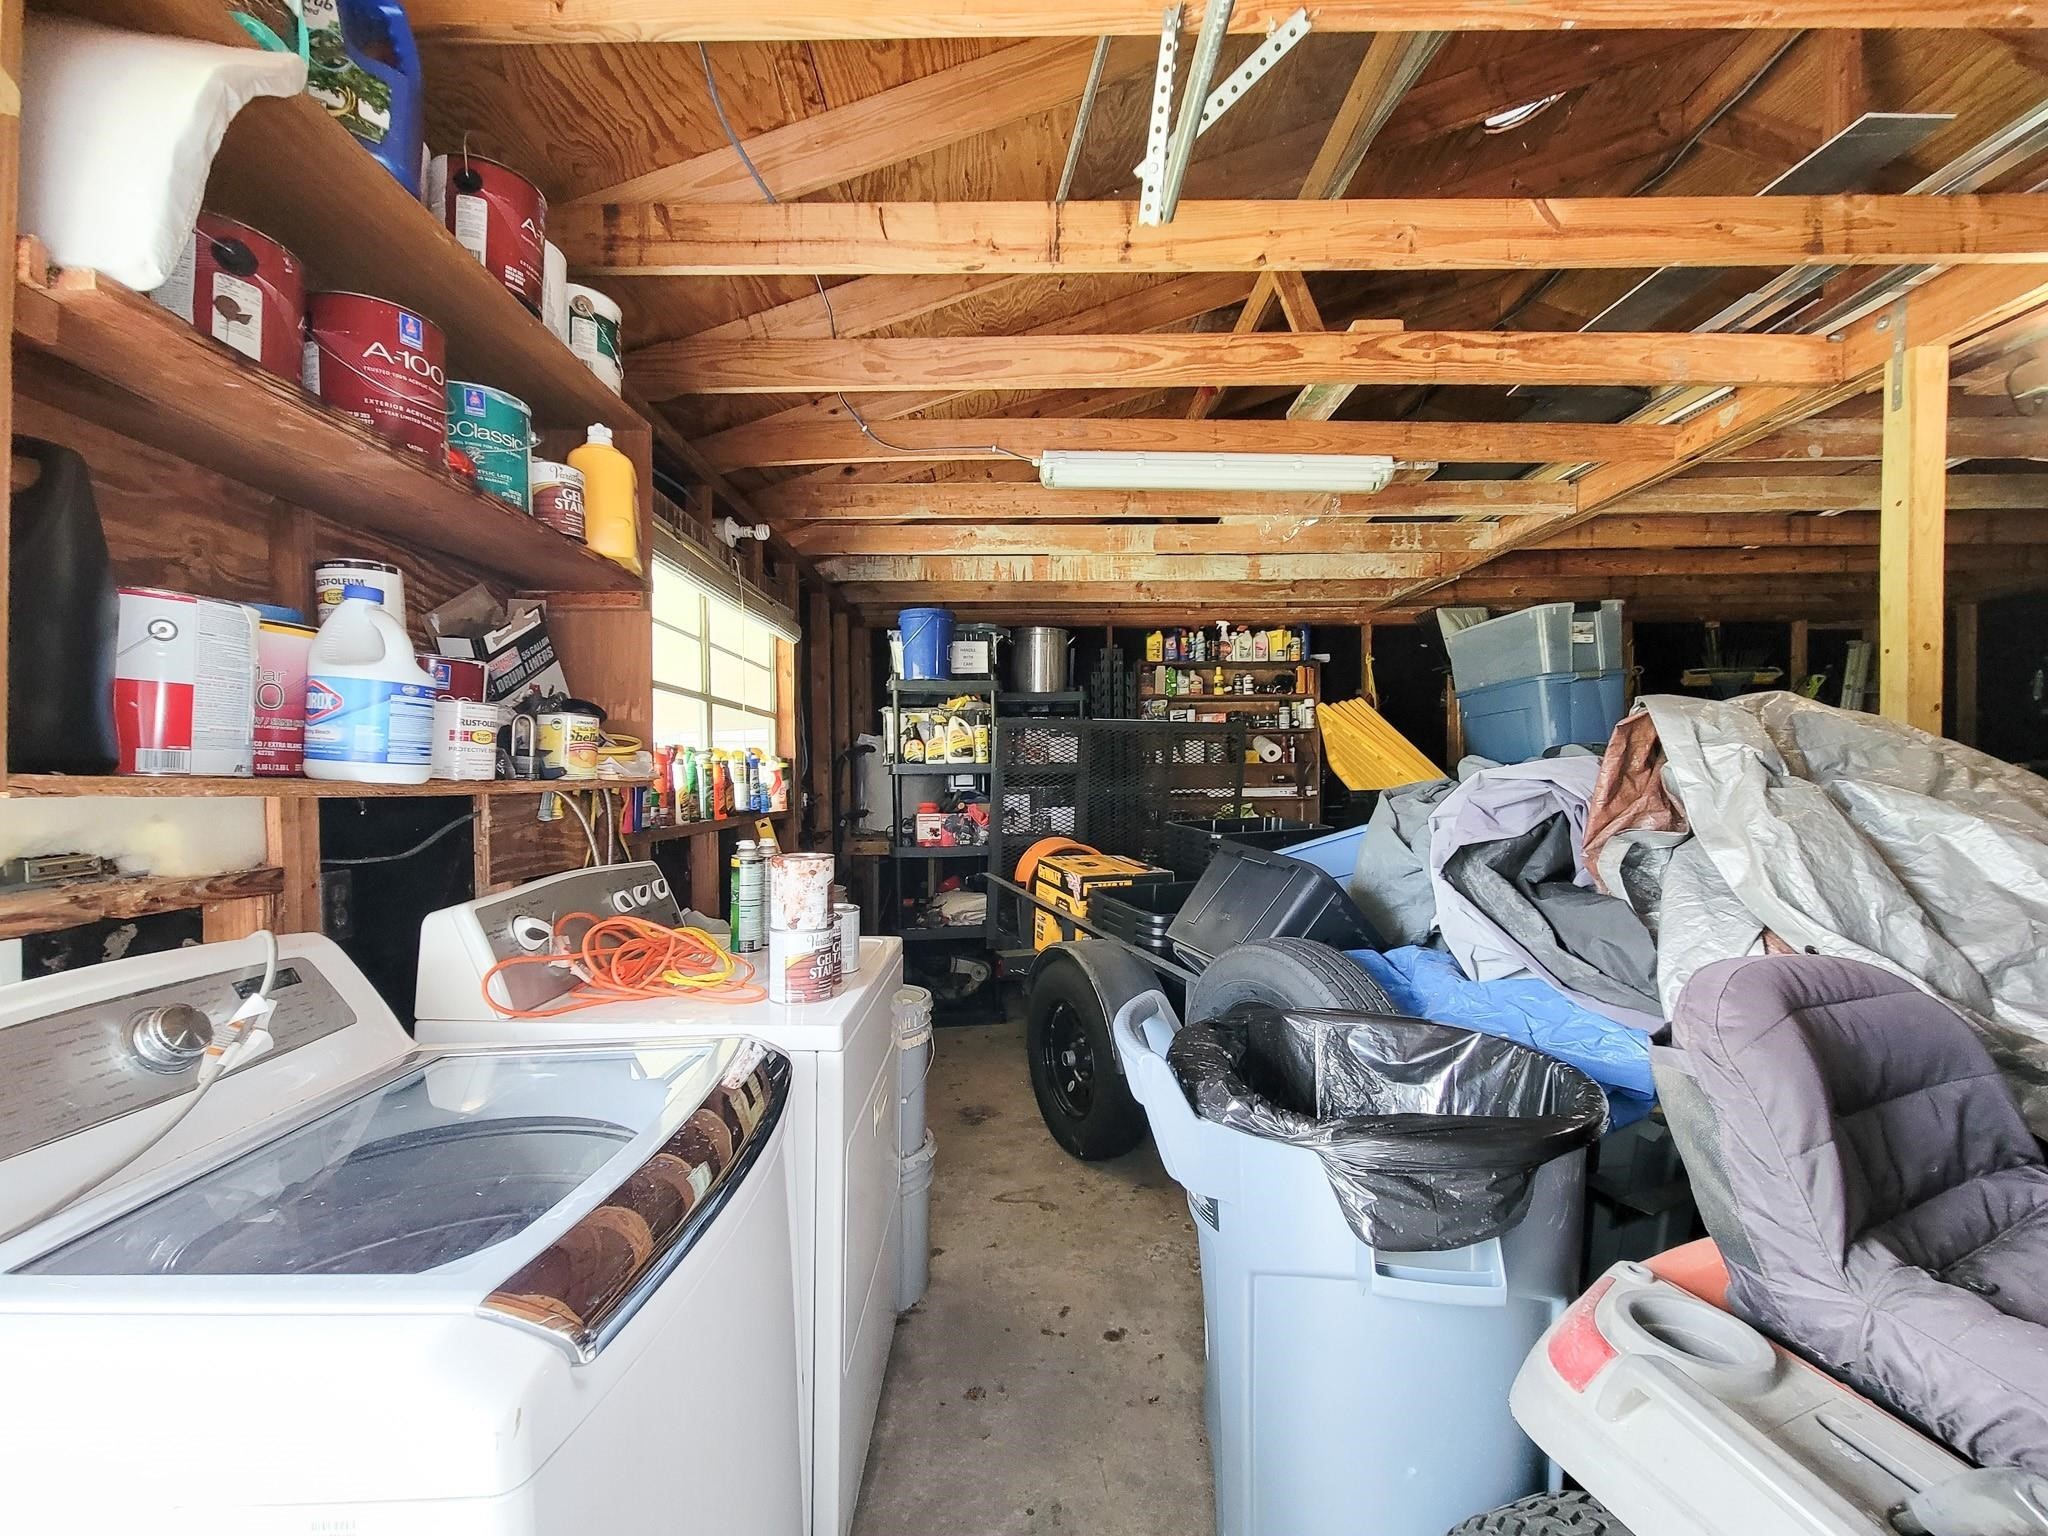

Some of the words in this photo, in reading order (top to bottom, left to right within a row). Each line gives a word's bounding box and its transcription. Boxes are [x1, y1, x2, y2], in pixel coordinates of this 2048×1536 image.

[362, 341, 445, 386] A-100
[364, 397, 404, 412] EXTERIOR
[448, 420, 523, 449] oClassic
[496, 664, 526, 693] DRUM
[525, 645, 554, 674] LINERS
[521, 649, 531, 660] 55
